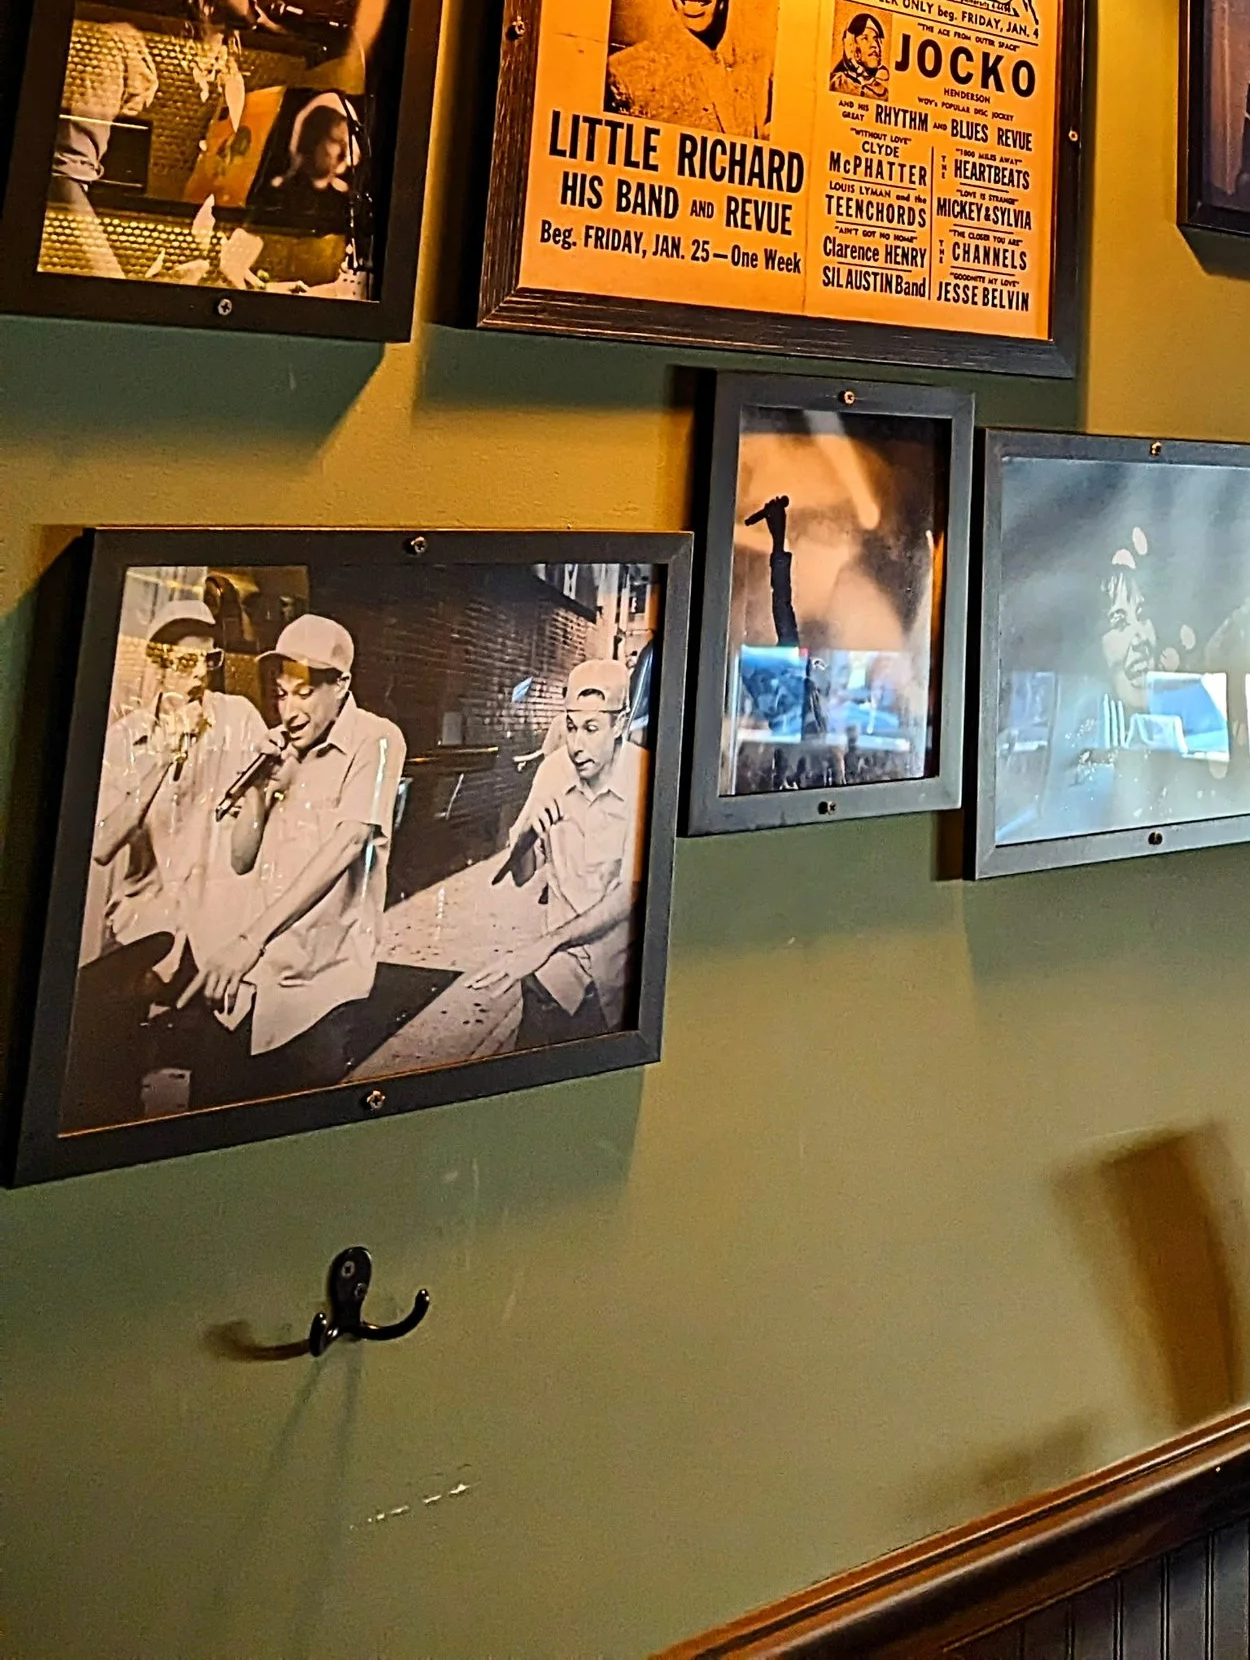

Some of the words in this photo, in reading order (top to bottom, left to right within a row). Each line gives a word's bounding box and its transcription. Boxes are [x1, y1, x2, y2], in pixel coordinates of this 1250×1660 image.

[937, 6, 958, 22] beg.
[961, 10, 1003, 33] FRIDAY,
[1006, 23, 1030, 38] JAN.
[1033, 28, 1039, 40] 4
[937, 26, 950, 37] ACE
[954, 31, 971, 41] FROM
[975, 35, 996, 47] OUTER
[895, 33, 1036, 98] JOCKO
[838, 100, 854, 109] AND
[857, 103, 869, 112] HIS
[944, 88, 990, 104] HENDERSON
[842, 110, 865, 121] GREAT
[941, 101, 970, 114] POPULAR
[974, 108, 988, 118] DISC
[992, 111, 1014, 122] JOCKEY
[875, 104, 929, 132] RHYTHM
[933, 122, 948, 131] AND
[951, 118, 989, 143] BLUES
[997, 127, 1033, 151] REVUE
[549, 110, 660, 172] LITTLE
[677, 132, 804, 194] RICHARD
[862, 141, 900, 158] CLYDE
[978, 153, 997, 161] MILES
[829, 151, 927, 186] McPHATTER
[954, 158, 1030, 190] HEARTBEATS
[560, 171, 604, 209] HIS
[616, 178, 680, 219] BAND
[690, 199, 715, 219] AND
[725, 195, 792, 236] REVUE
[829, 180, 855, 194] LOUIS
[859, 184, 891, 198] LYMAN
[896, 193, 910, 202] and
[914, 194, 927, 204] the
[825, 194, 927, 228] TEENCHORDS
[540, 219, 577, 250] Beg.
[584, 225, 647, 259] FRIDAY,
[652, 233, 685, 259] JAN.
[764, 248, 801, 274] Week
[862, 229, 877, 239] GOT
[880, 232, 890, 240] NO
[968, 232, 990, 242] CLOSER
[993, 236, 1005, 244] YOU
[823, 236, 880, 262] Clarence
[884, 243, 927, 269] HENRY
[952, 242, 1027, 271] CHANNELS
[988, 277, 998, 285] MY
[937, 281, 979, 306] JESSE
[982, 287, 1029, 312] BELVIN
